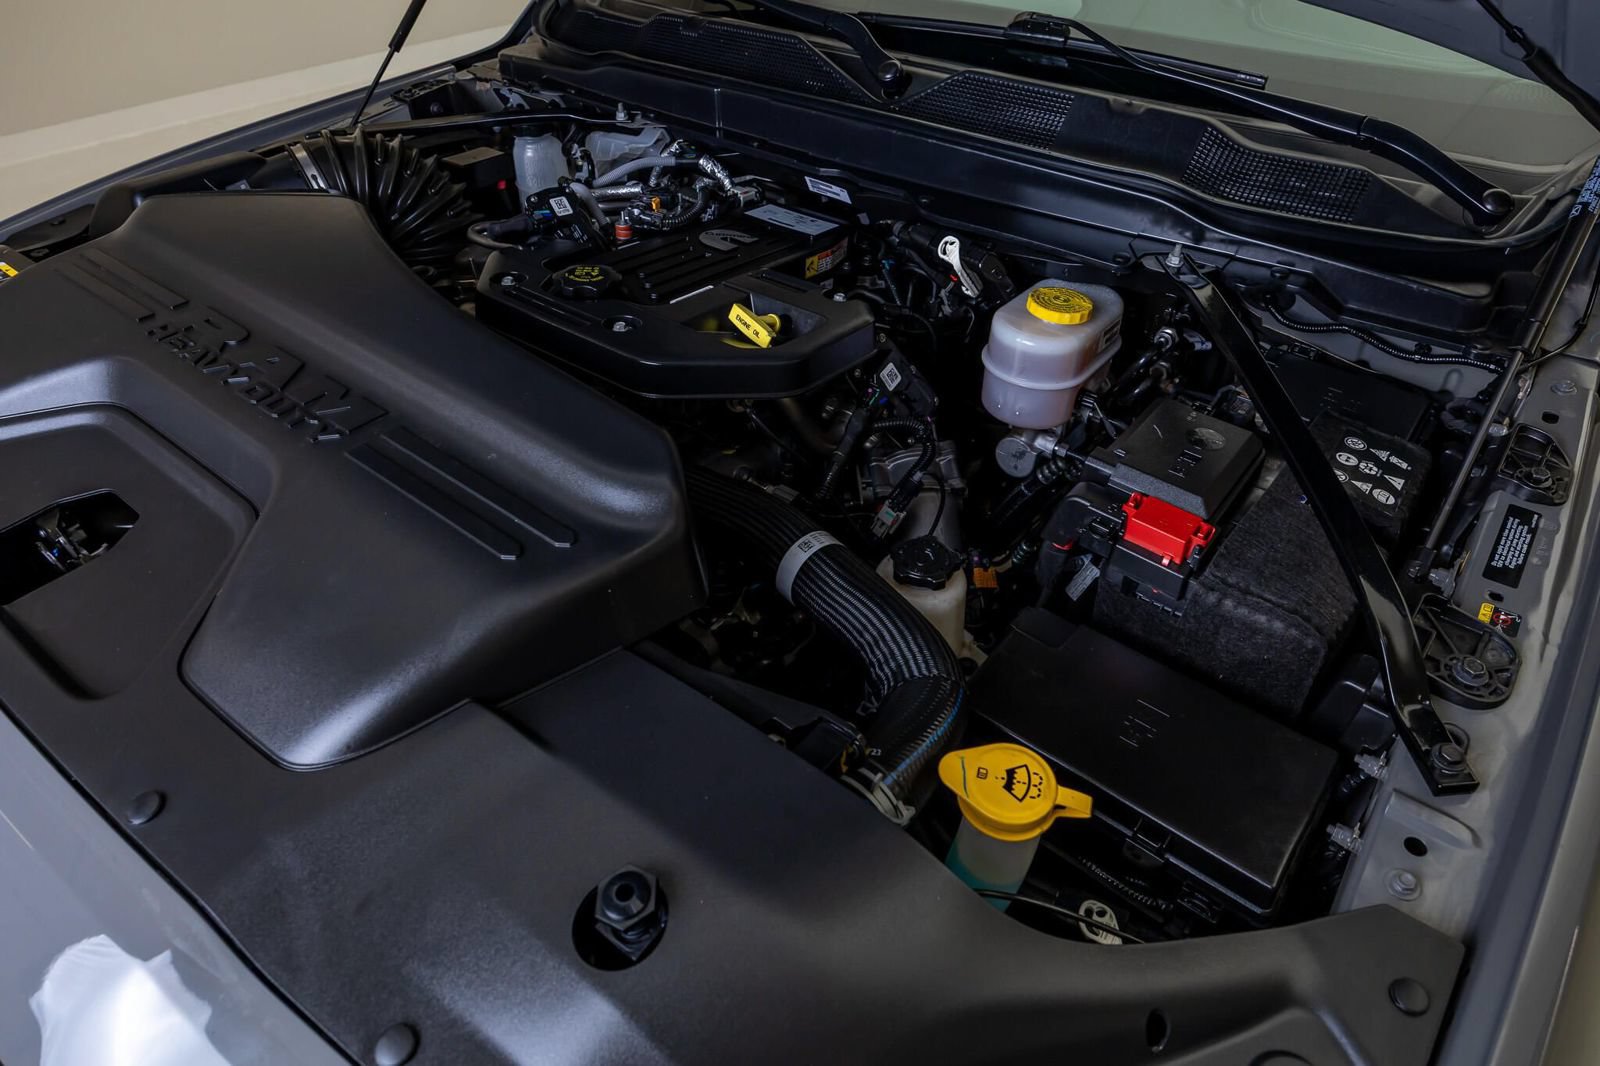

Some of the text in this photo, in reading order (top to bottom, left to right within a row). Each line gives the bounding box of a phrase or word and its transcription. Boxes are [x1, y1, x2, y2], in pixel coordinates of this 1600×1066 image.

[146, 324, 341, 443] HEAVY DUTY
[183, 306, 389, 433] RAM
[735, 314, 761, 339] ENGINE OIL
